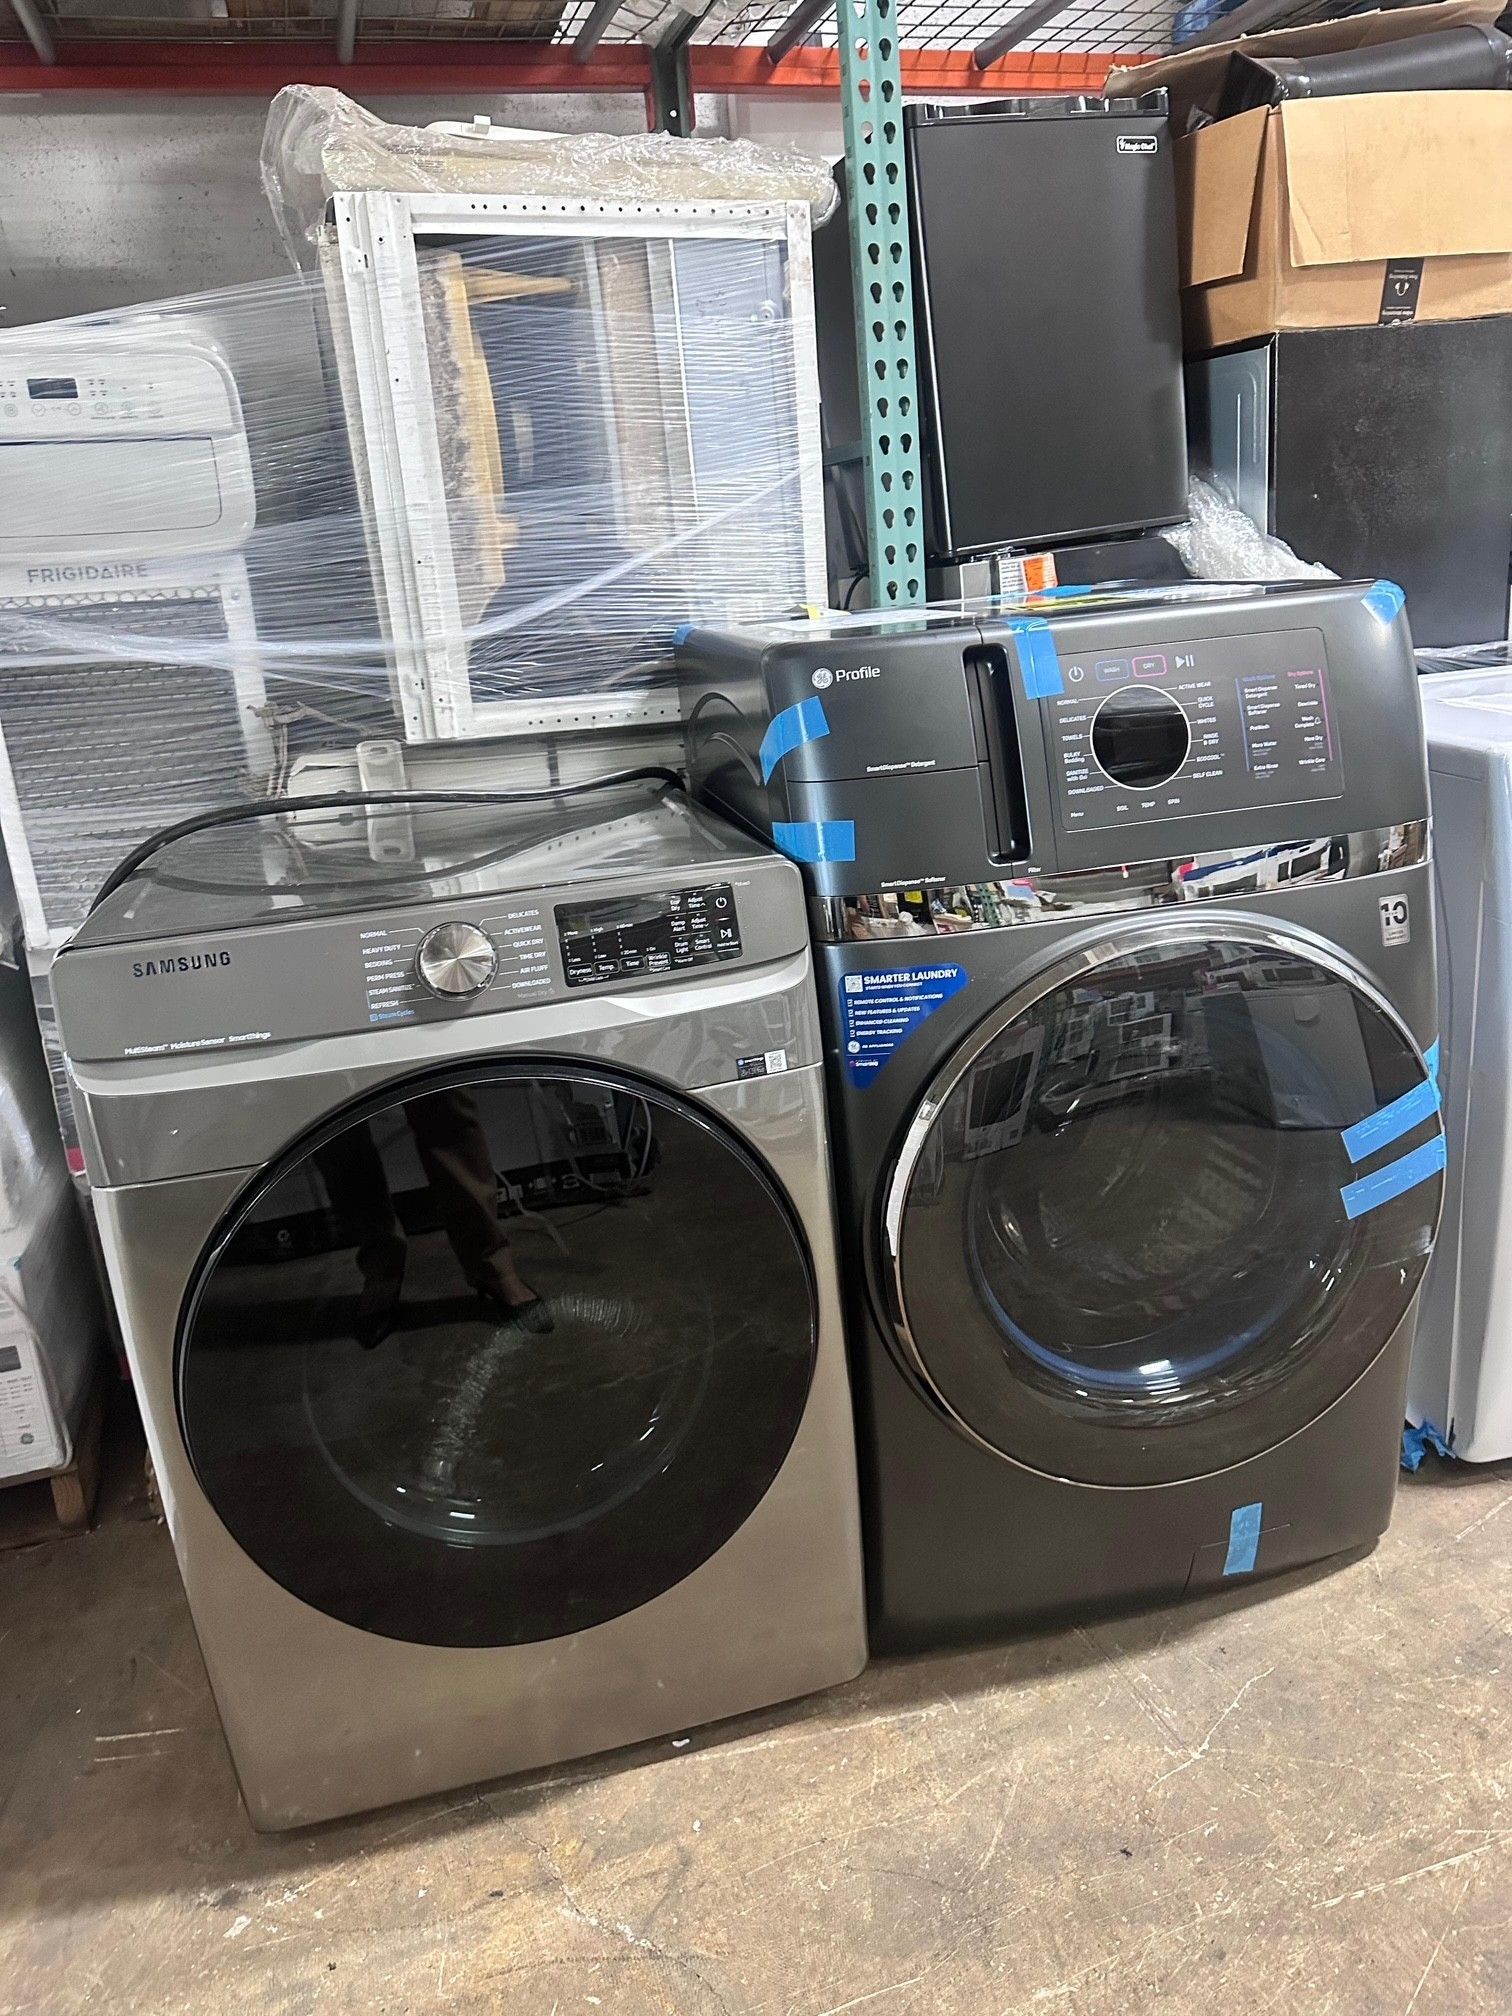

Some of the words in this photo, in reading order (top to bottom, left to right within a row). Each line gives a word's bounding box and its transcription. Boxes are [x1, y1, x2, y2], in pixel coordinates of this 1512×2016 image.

[27, 564, 148, 583] FRIGIDAIRE
[835, 666, 881, 682] Profile
[1059, 715, 1087, 723] DELICATES
[1062, 733, 1083, 741] TOWELS
[1067, 785, 1104, 796] DOWNLOADED
[1027, 866, 1042, 874] Filter
[507, 909, 540, 919] DELICATES
[1381, 901, 1407, 926] 10
[360, 930, 388, 939] NORMAL
[504, 925, 542, 935] ACTIVEWEAR
[513, 940, 531, 948] QUICK
[532, 938, 544, 946] DRY
[362, 947, 383, 955] HEAVY
[384, 944, 401, 952] DUTY
[133, 951, 231, 978] SAMSUNG
[364, 959, 393, 968] BEDDING
[531, 964, 549, 972] FLUFF
[366, 973, 385, 982] PERM
[385, 971, 405, 979] PRESS
[569, 967, 592, 976] Dryness
[864, 972, 911, 985] SMARTER
[912, 968, 958, 981] LAUNDRY
[511, 978, 551, 989] DOWNLOADED
[369, 988, 388, 996] STEAM
[905, 993, 943, 1001] NOTIFICATIONS
[370, 1000, 399, 1010] REFRESH
[396, 1009, 415, 1017] Cycles
[170, 1040, 200, 1050] Moisture
[200, 1037, 226, 1046] Sensor
[228, 1031, 272, 1042] SmartThings
